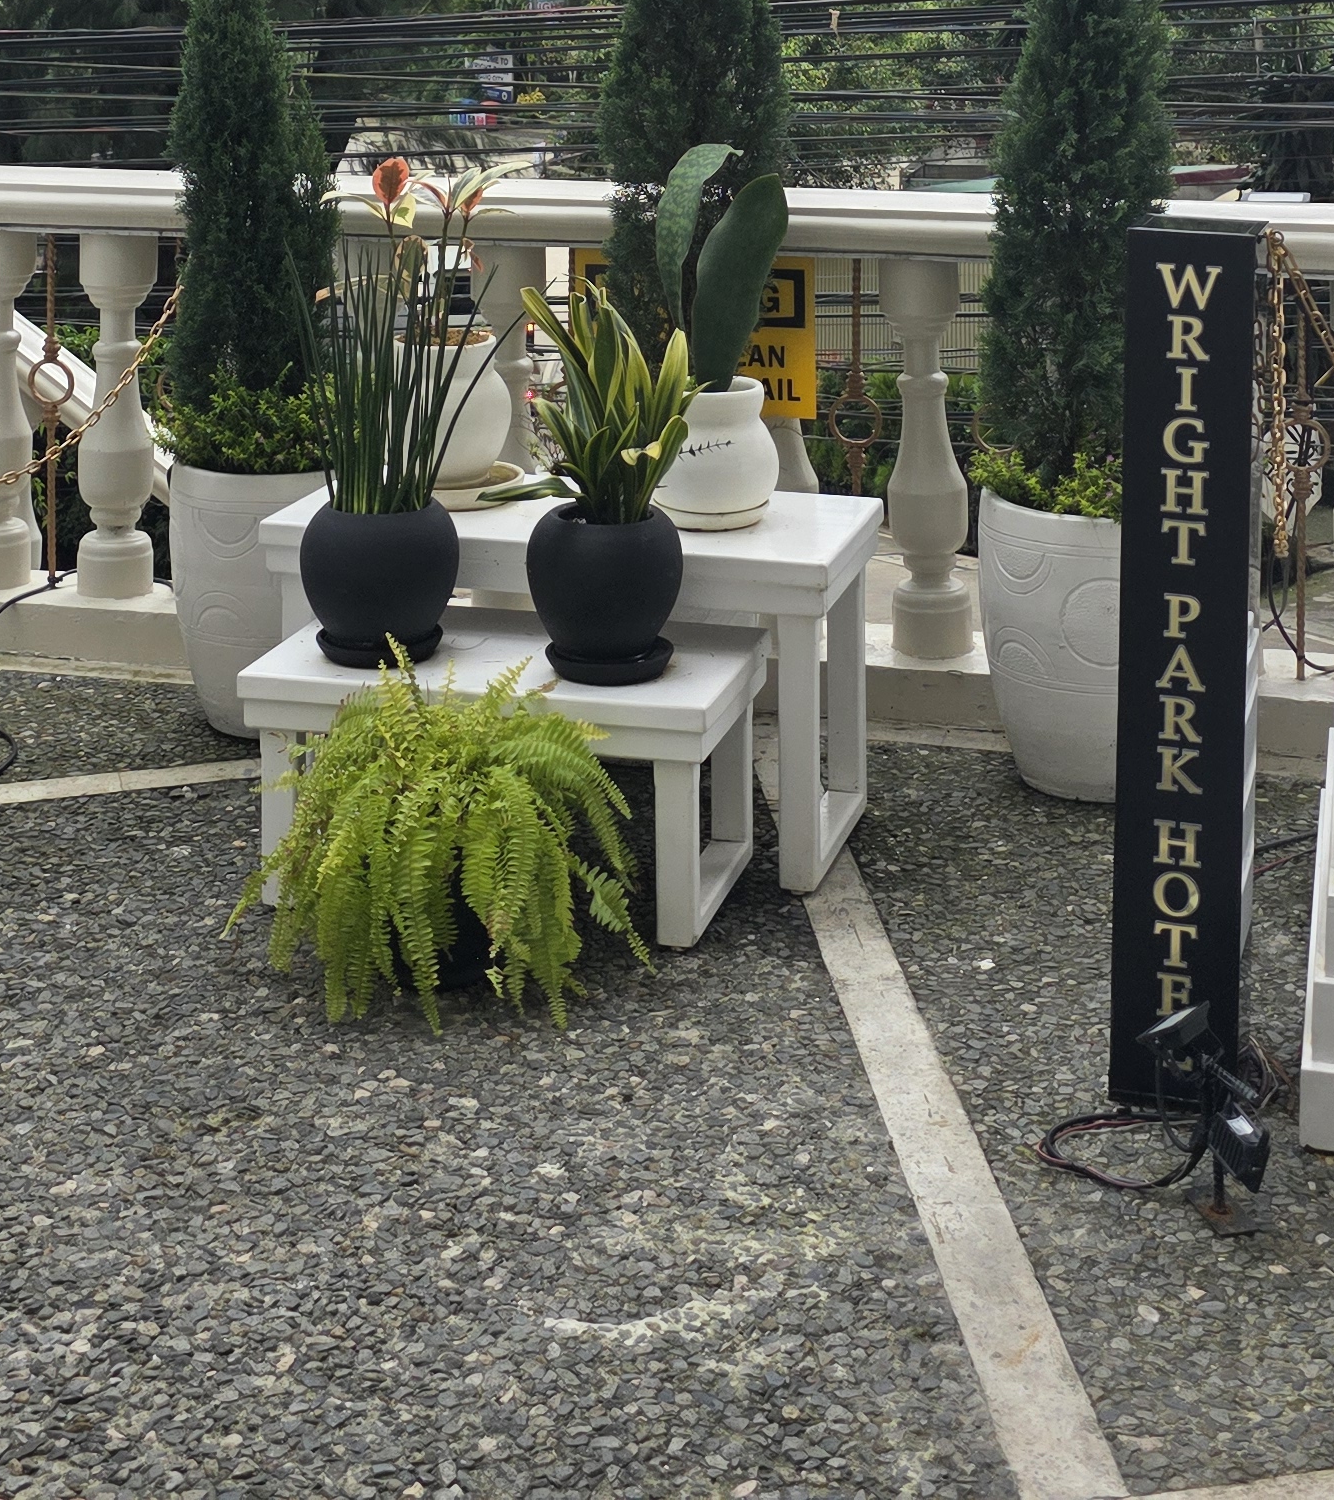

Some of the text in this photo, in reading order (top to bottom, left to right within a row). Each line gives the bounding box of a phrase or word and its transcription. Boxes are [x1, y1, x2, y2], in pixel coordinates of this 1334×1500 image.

[1153, 262, 1223, 1016] WRIGHT PARK HOTE
